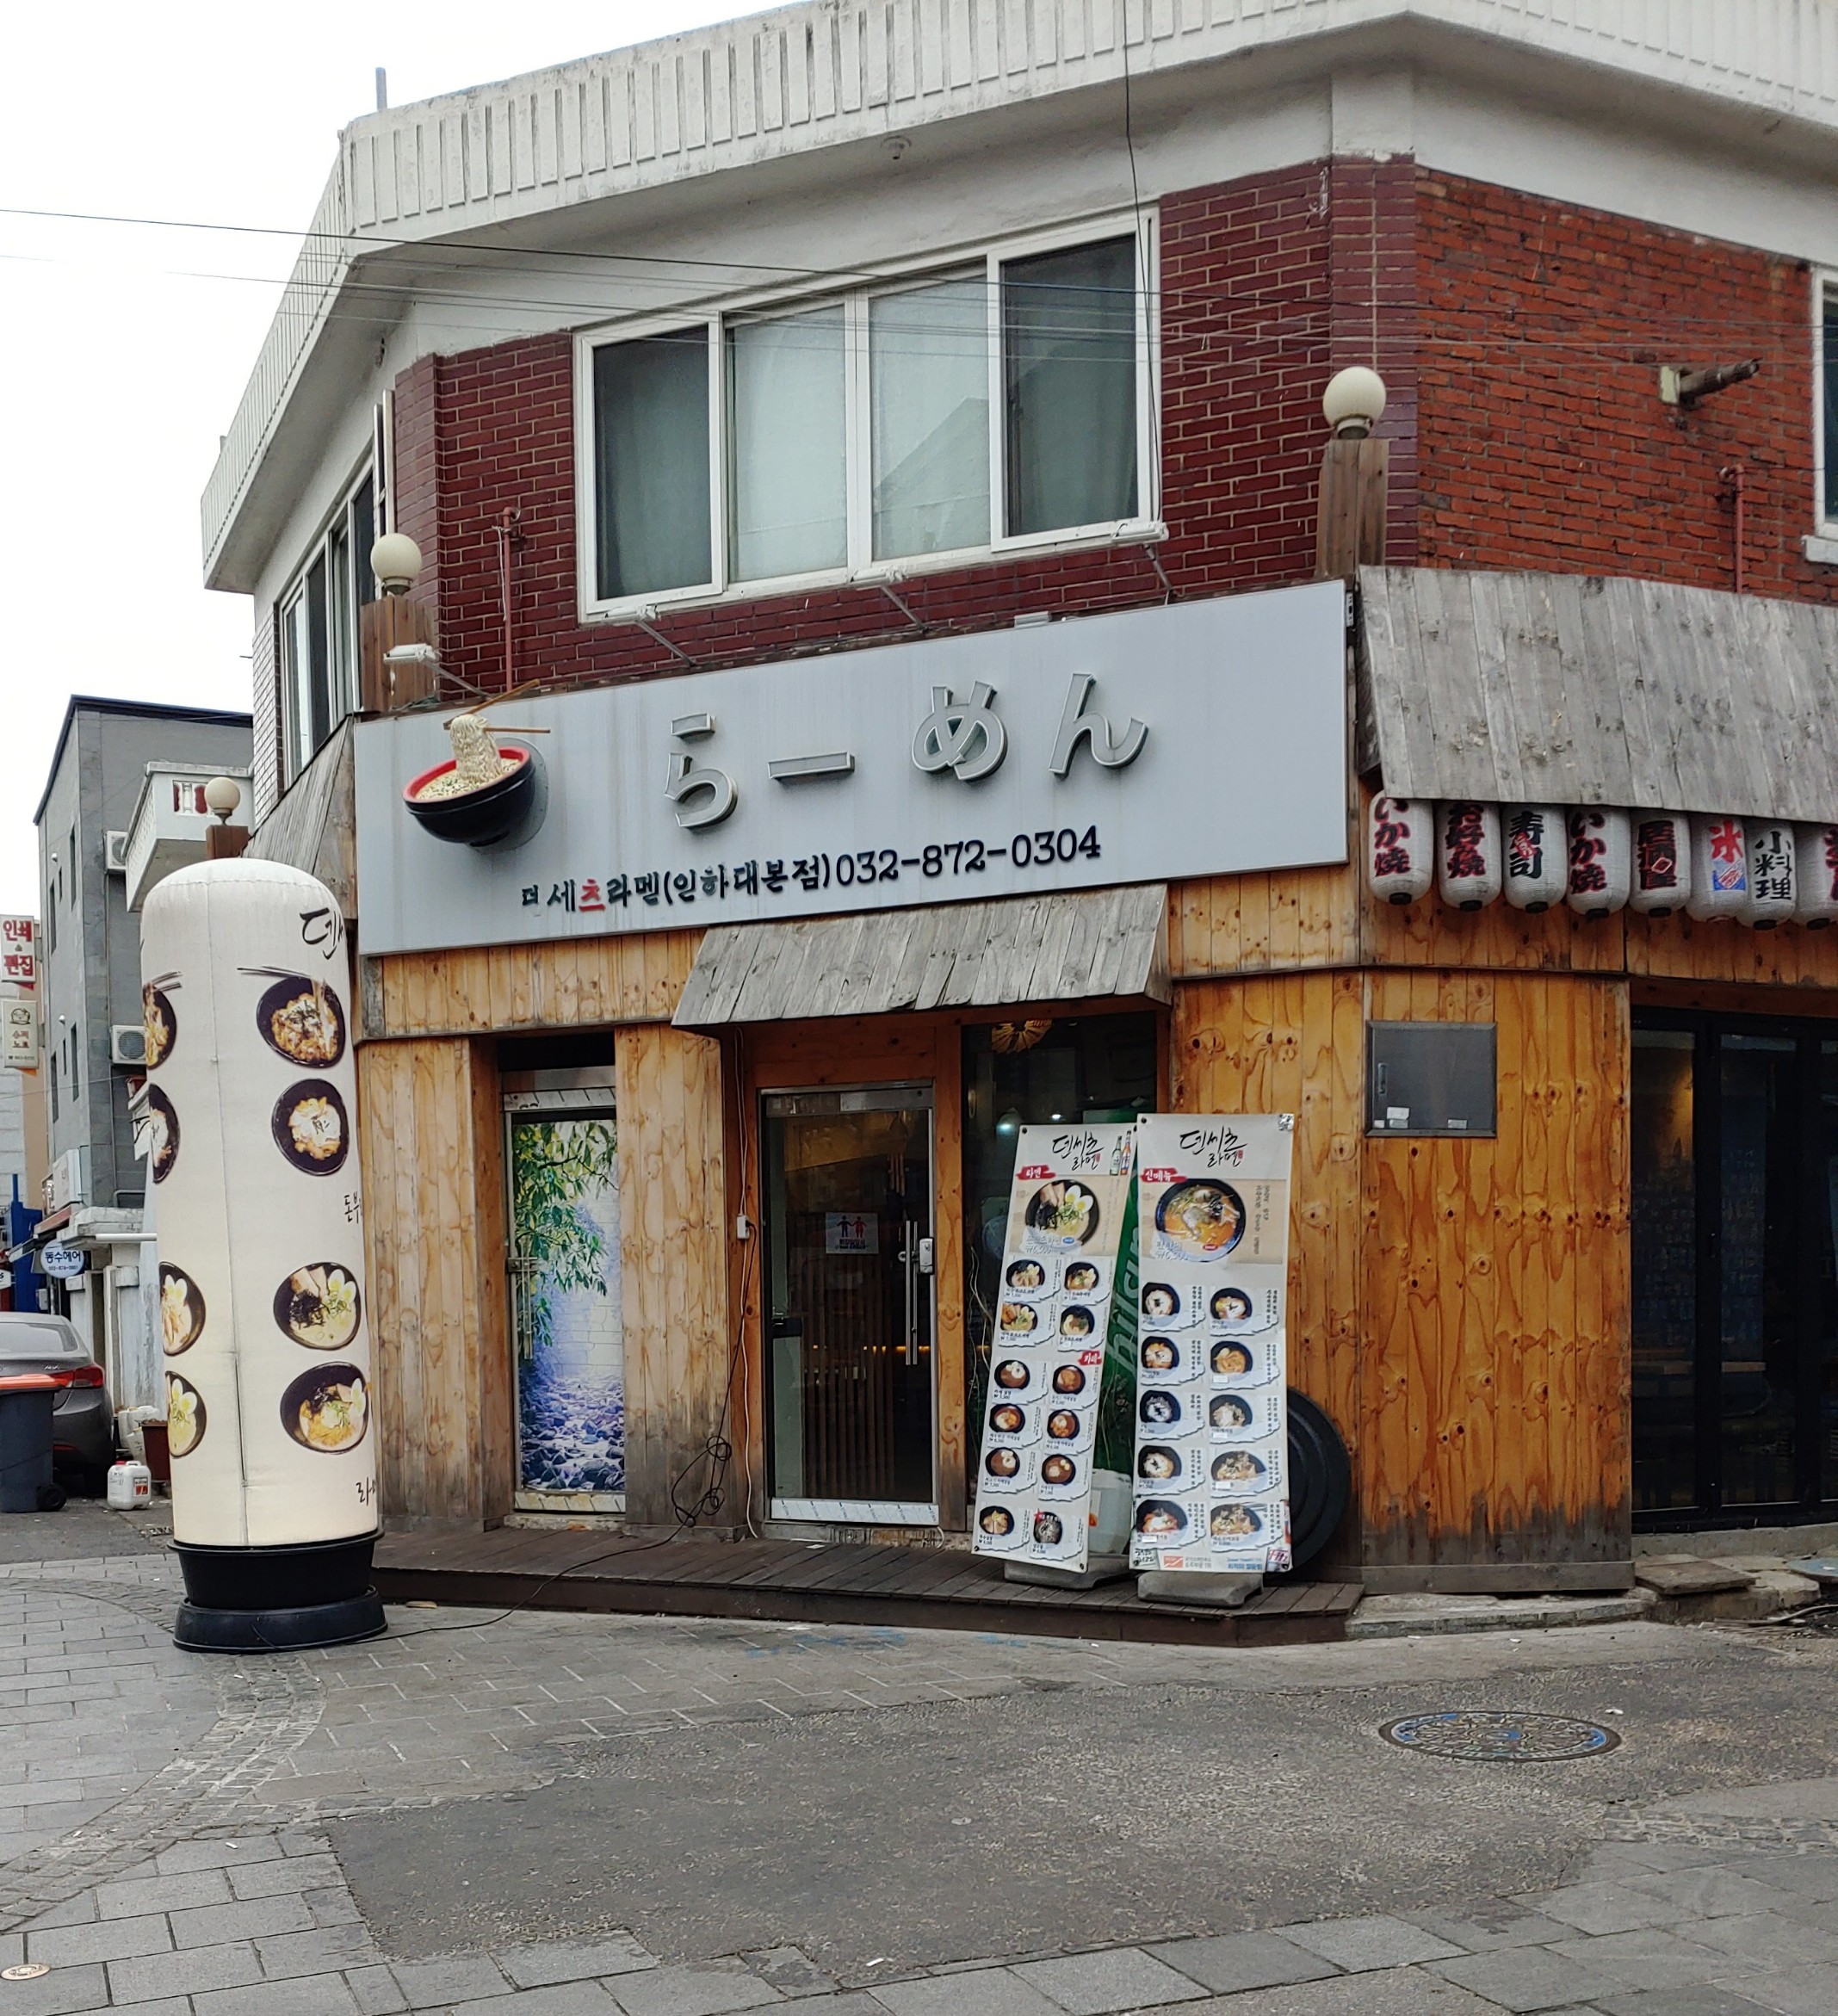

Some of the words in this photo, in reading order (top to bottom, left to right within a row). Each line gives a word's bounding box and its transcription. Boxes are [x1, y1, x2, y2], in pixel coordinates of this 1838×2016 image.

[664, 673, 1149, 830] らーめん
[835, 825, 1101, 887] 032-872-0304
[1508, 810, 1545, 879] 寿司
[1709, 820, 1743, 863] 氷
[1754, 831, 1792, 901] 小料理
[3, 919, 32, 943] 인쇄
[3, 955, 34, 976] 편집
[1144, 1168, 1173, 1182] 신메뉴
[45, 1251, 82, 1264] 동수헤어
